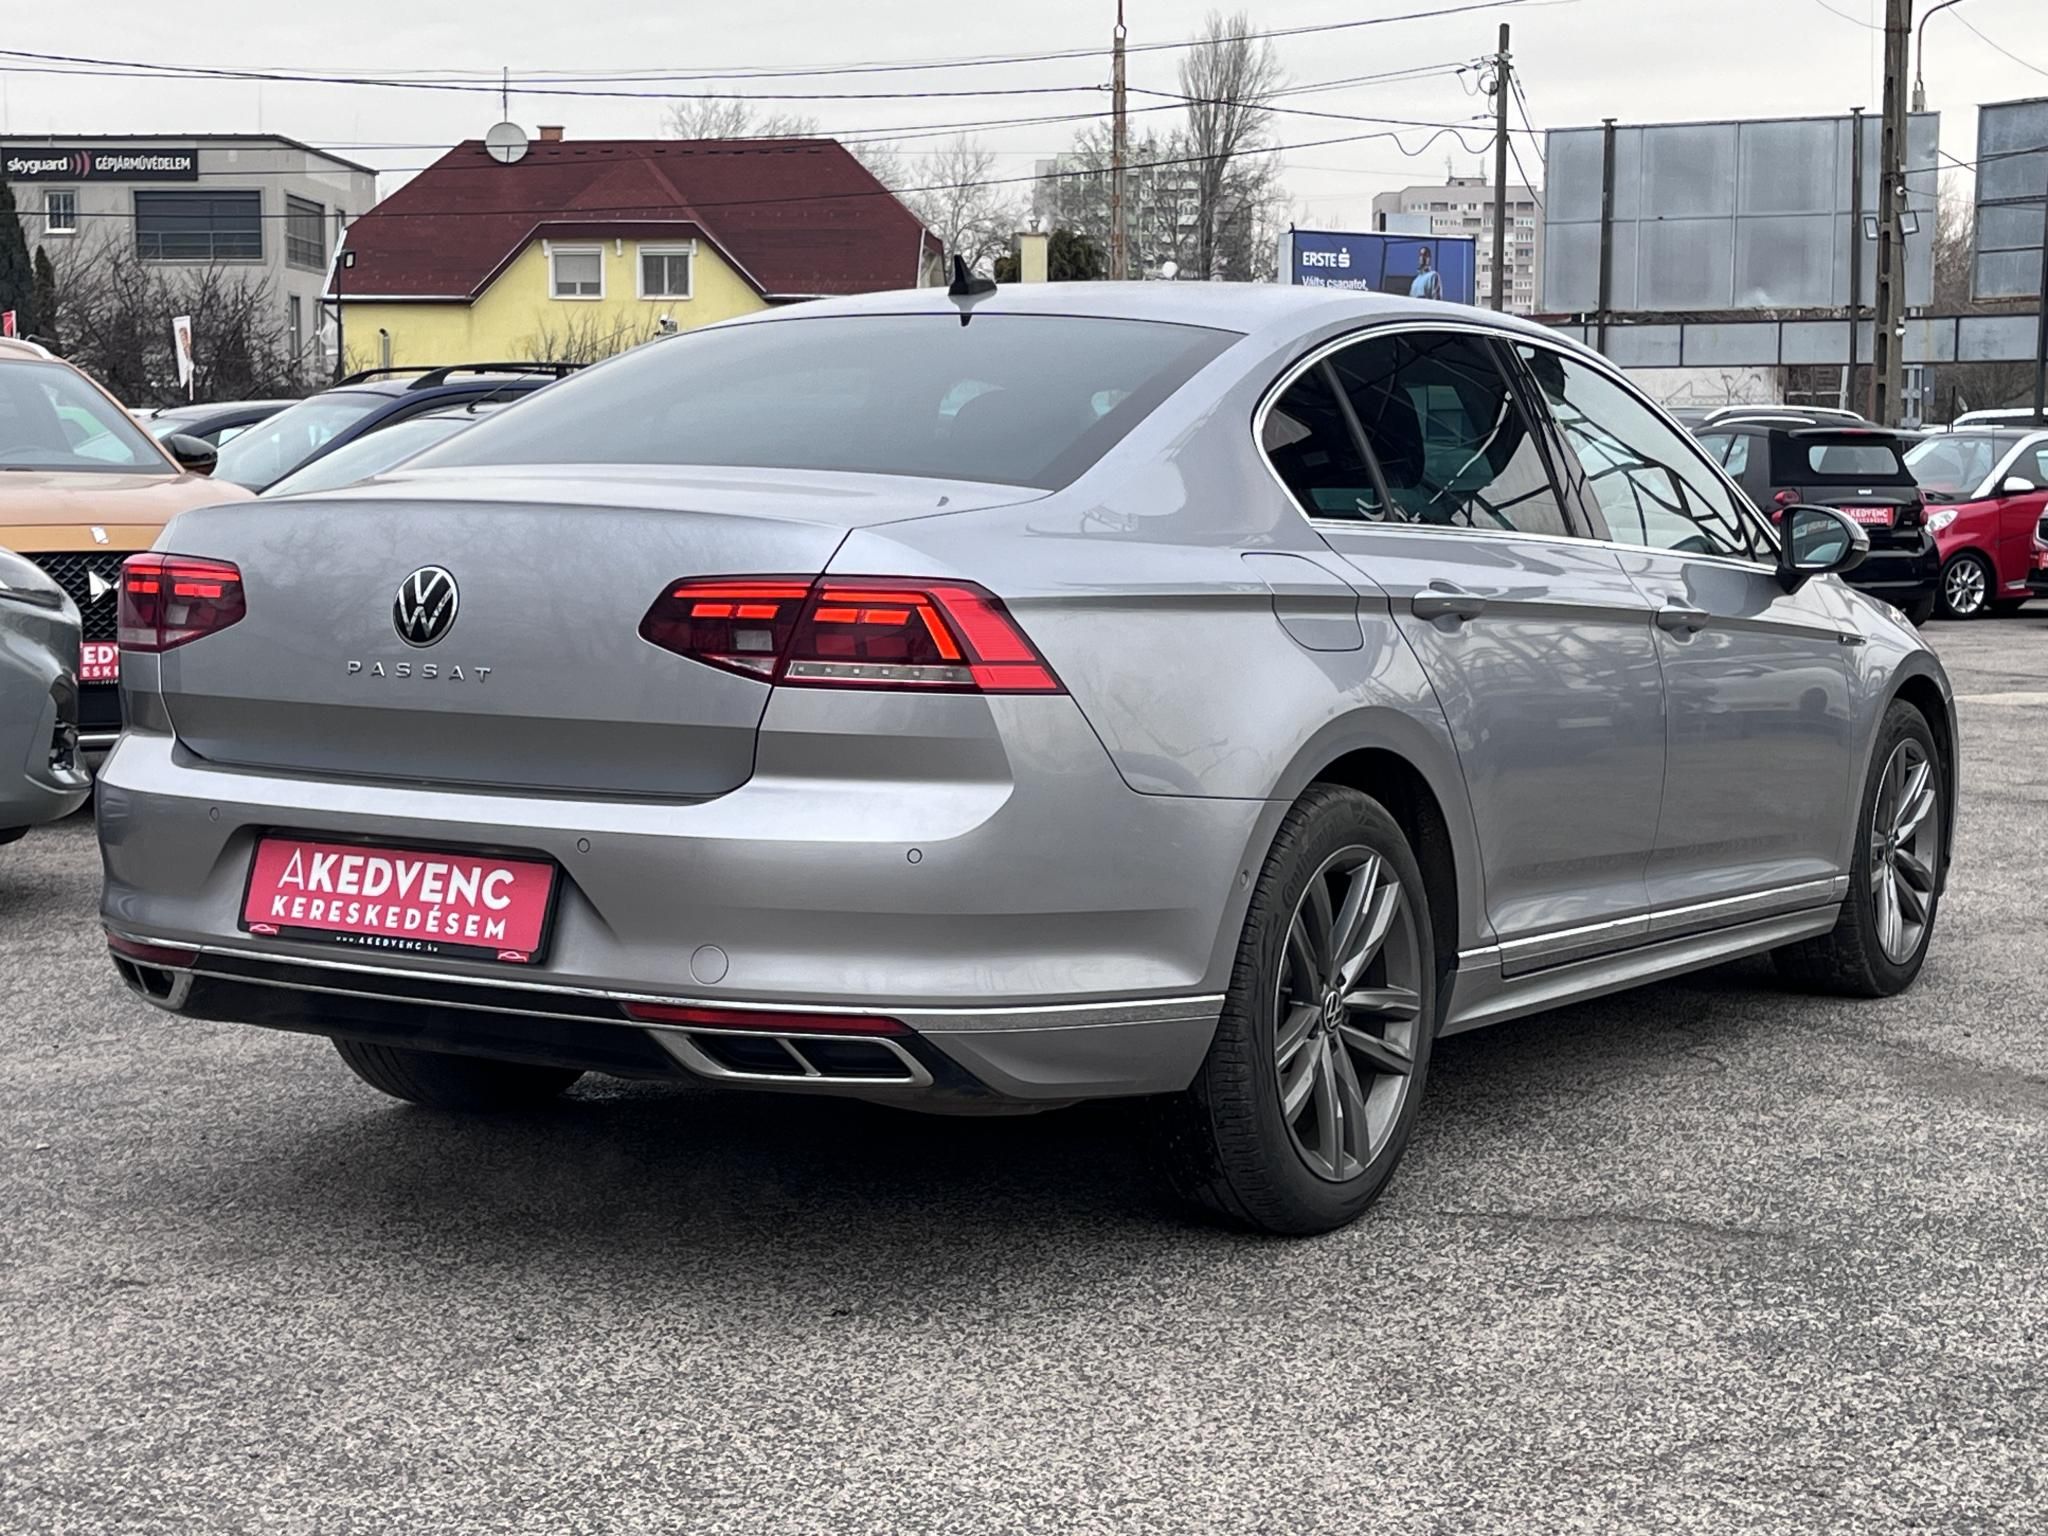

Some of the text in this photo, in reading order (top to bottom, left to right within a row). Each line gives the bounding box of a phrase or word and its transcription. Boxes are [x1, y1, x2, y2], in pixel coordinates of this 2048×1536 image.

[7, 156, 68, 174] skyguard
[1303, 251, 1337, 267] ERSTE
[347, 660, 491, 682] PASSAT
[277, 847, 514, 910] AKEDVENC
[271, 895, 506, 940] KERESKEDÉSEM
